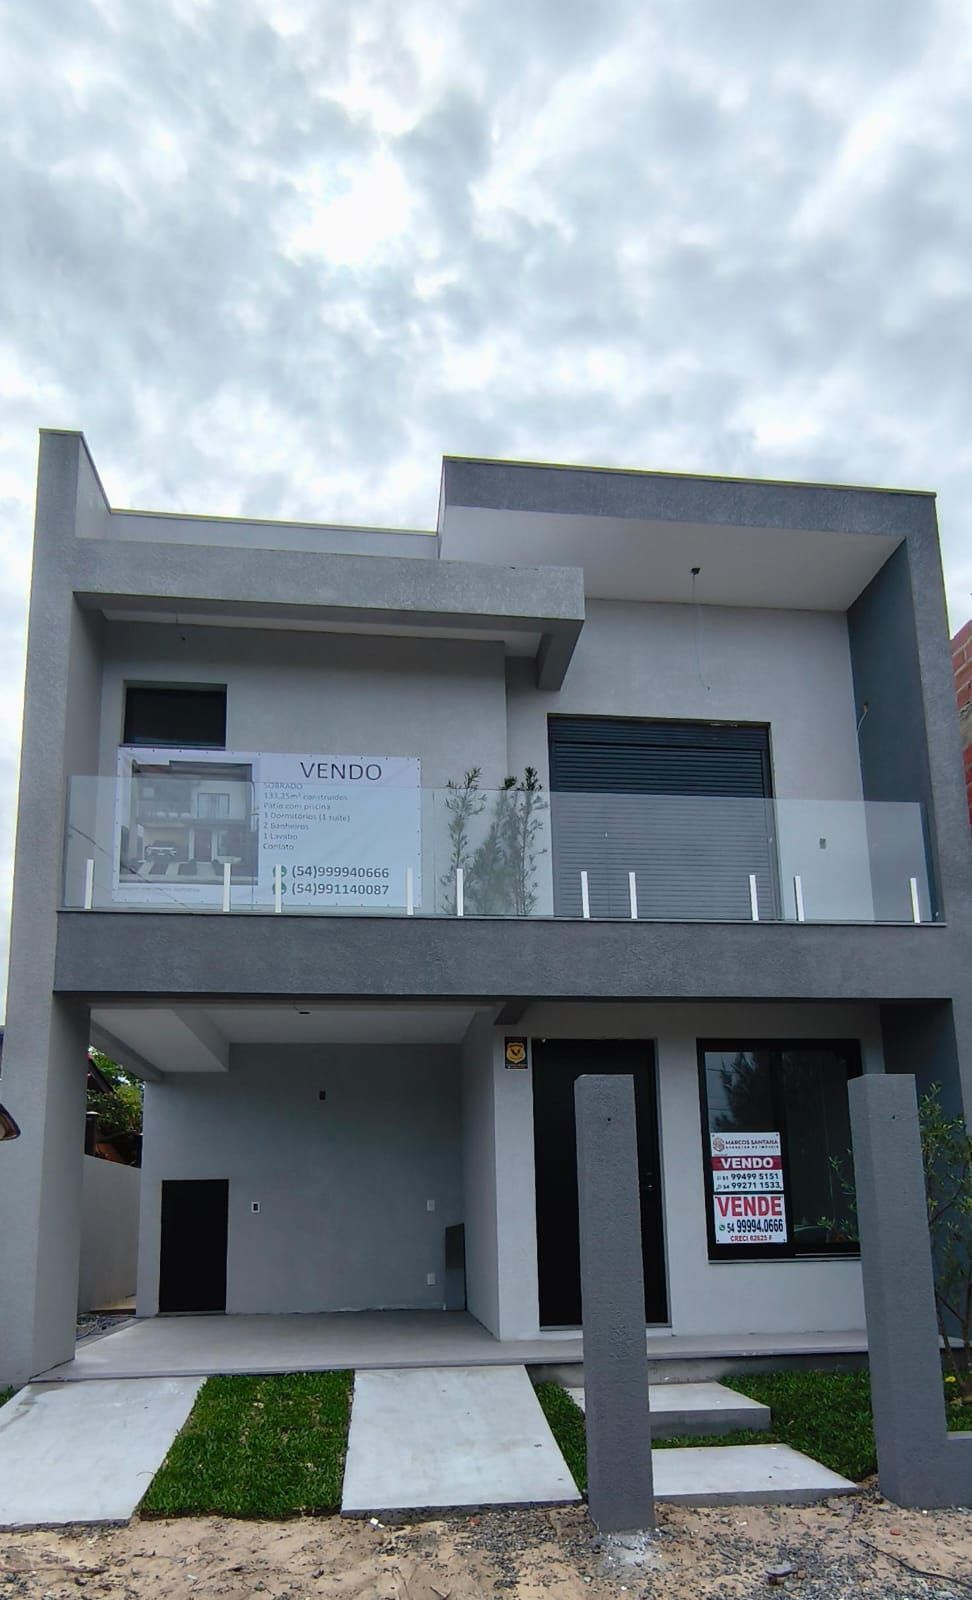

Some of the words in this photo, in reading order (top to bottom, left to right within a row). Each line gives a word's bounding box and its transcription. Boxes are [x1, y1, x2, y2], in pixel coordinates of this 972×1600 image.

[300, 762, 382, 781] VENDO
[263, 782, 303, 790] SOBRADO
[303, 803, 331, 811] piscina
[319, 814, 326, 822] (1
[270, 822, 309, 831] Banheiros
[264, 832, 268, 840] 1
[270, 832, 298, 841] Lavabo
[291, 865, 389, 879] (54)999940666
[291, 882, 390, 896] (54)991140087
[721, 1157, 774, 1169] VENDO
[732, 1182, 757, 1190] 99271
[760, 1181, 780, 1189] 1533
[716, 1195, 783, 1217] VENDE
[727, 1223, 735, 1233] 54
[736, 1219, 784, 1233] 99994.0666
